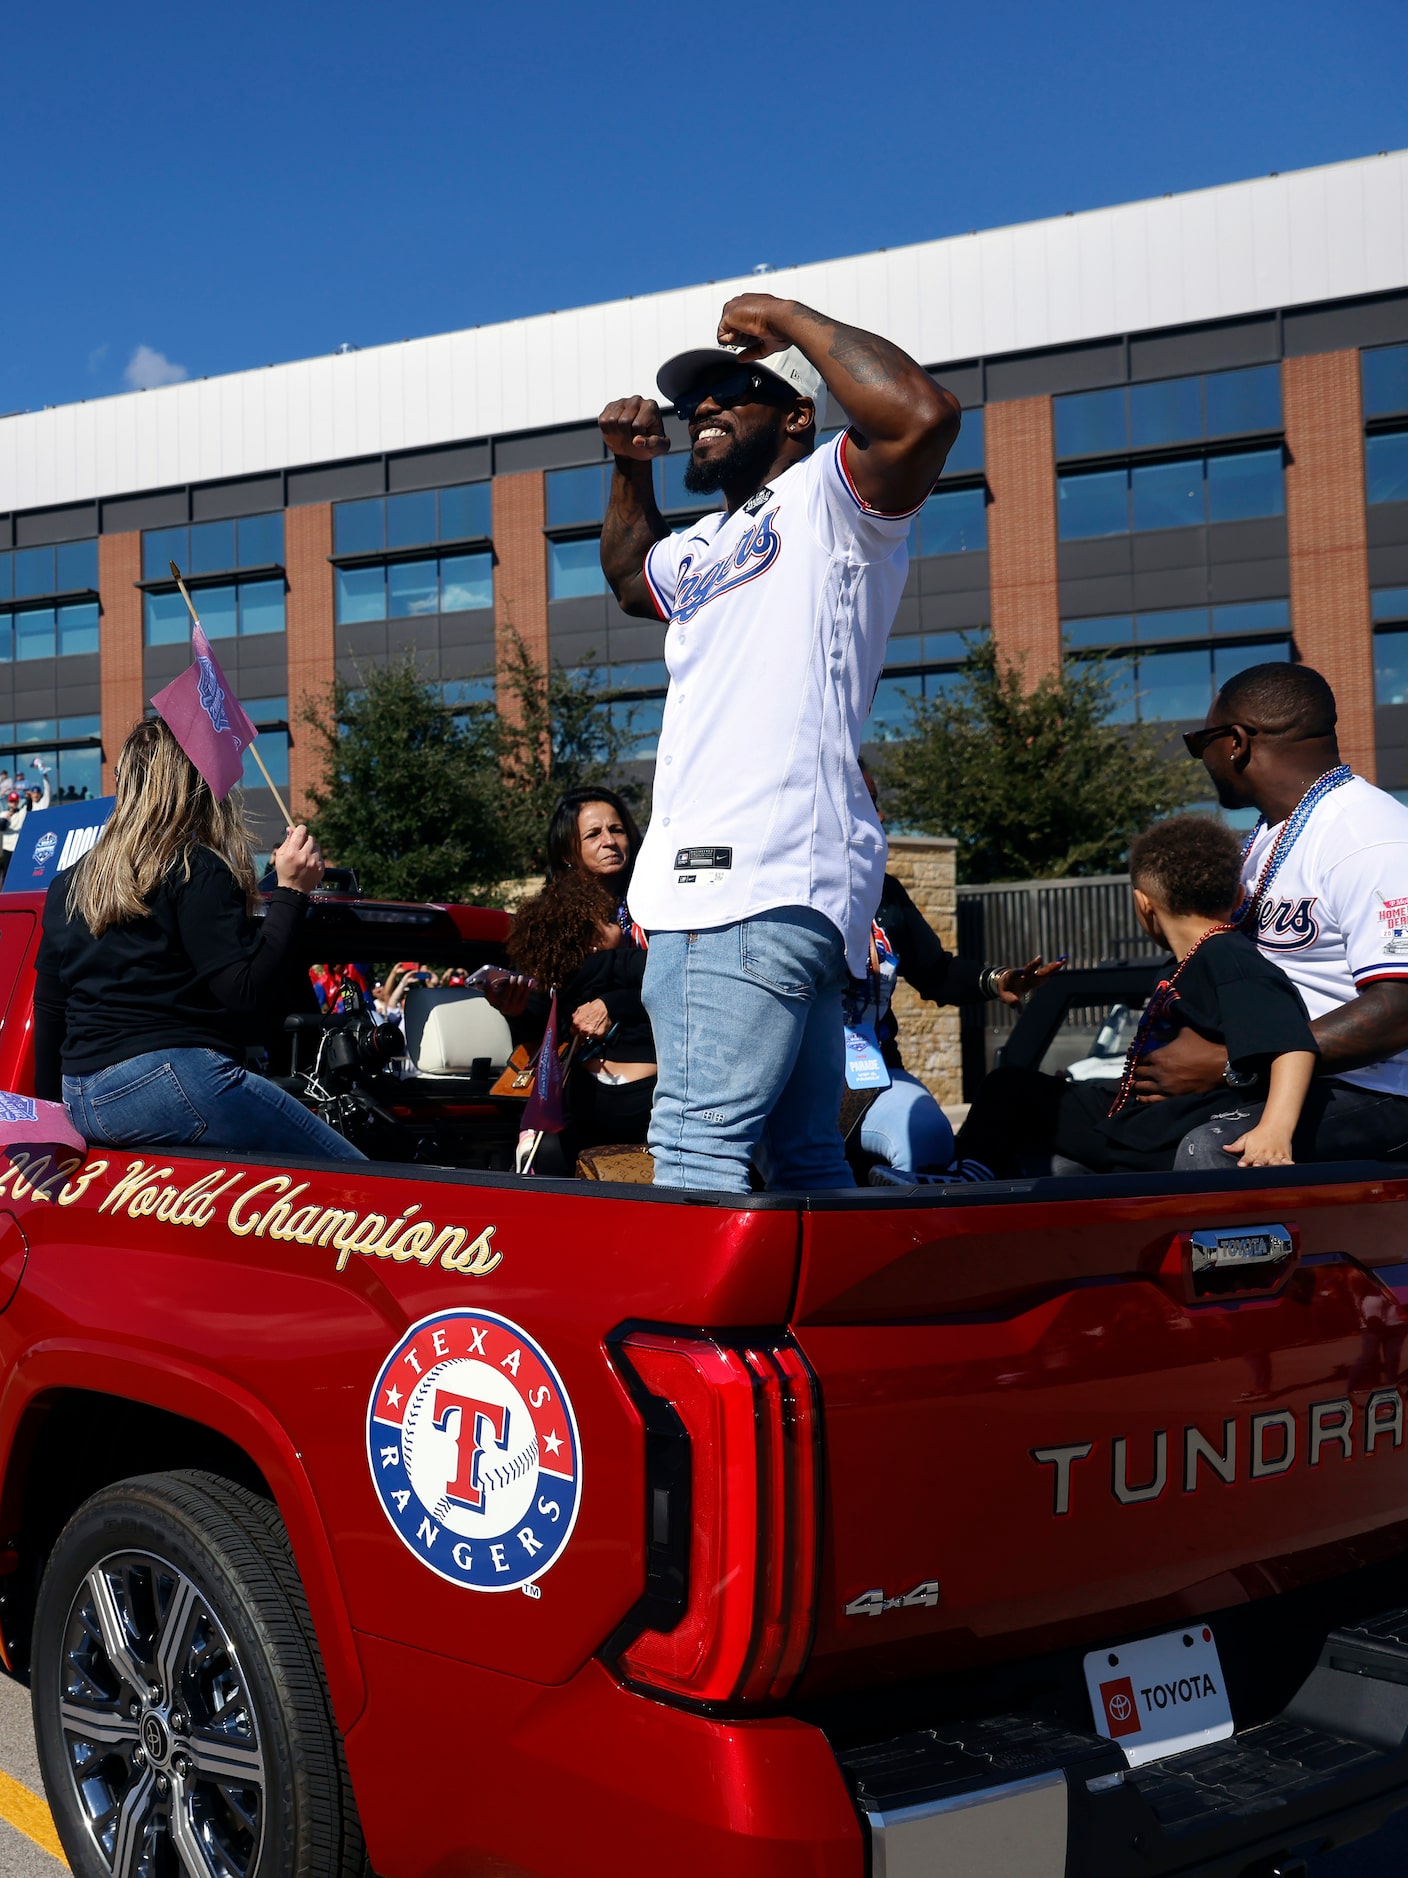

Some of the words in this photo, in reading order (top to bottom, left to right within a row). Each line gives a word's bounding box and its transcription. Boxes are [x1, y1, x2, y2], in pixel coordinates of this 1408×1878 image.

[1379, 907, 1406, 920] HOME
[1388, 916, 1408, 929] DER
[849, 1060, 879, 1072] PARADE
[97, 1159, 247, 1229] World
[226, 1174, 504, 1277] Champions
[1220, 1237, 1268, 1259] TOYOTA
[404, 1326, 551, 1408] TEXAS
[432, 1388, 511, 1515] T
[1033, 1387, 1404, 1517] TUNDRA
[379, 1445, 560, 1573] RANGERS
[1140, 1673, 1217, 1712] TOYOTA
